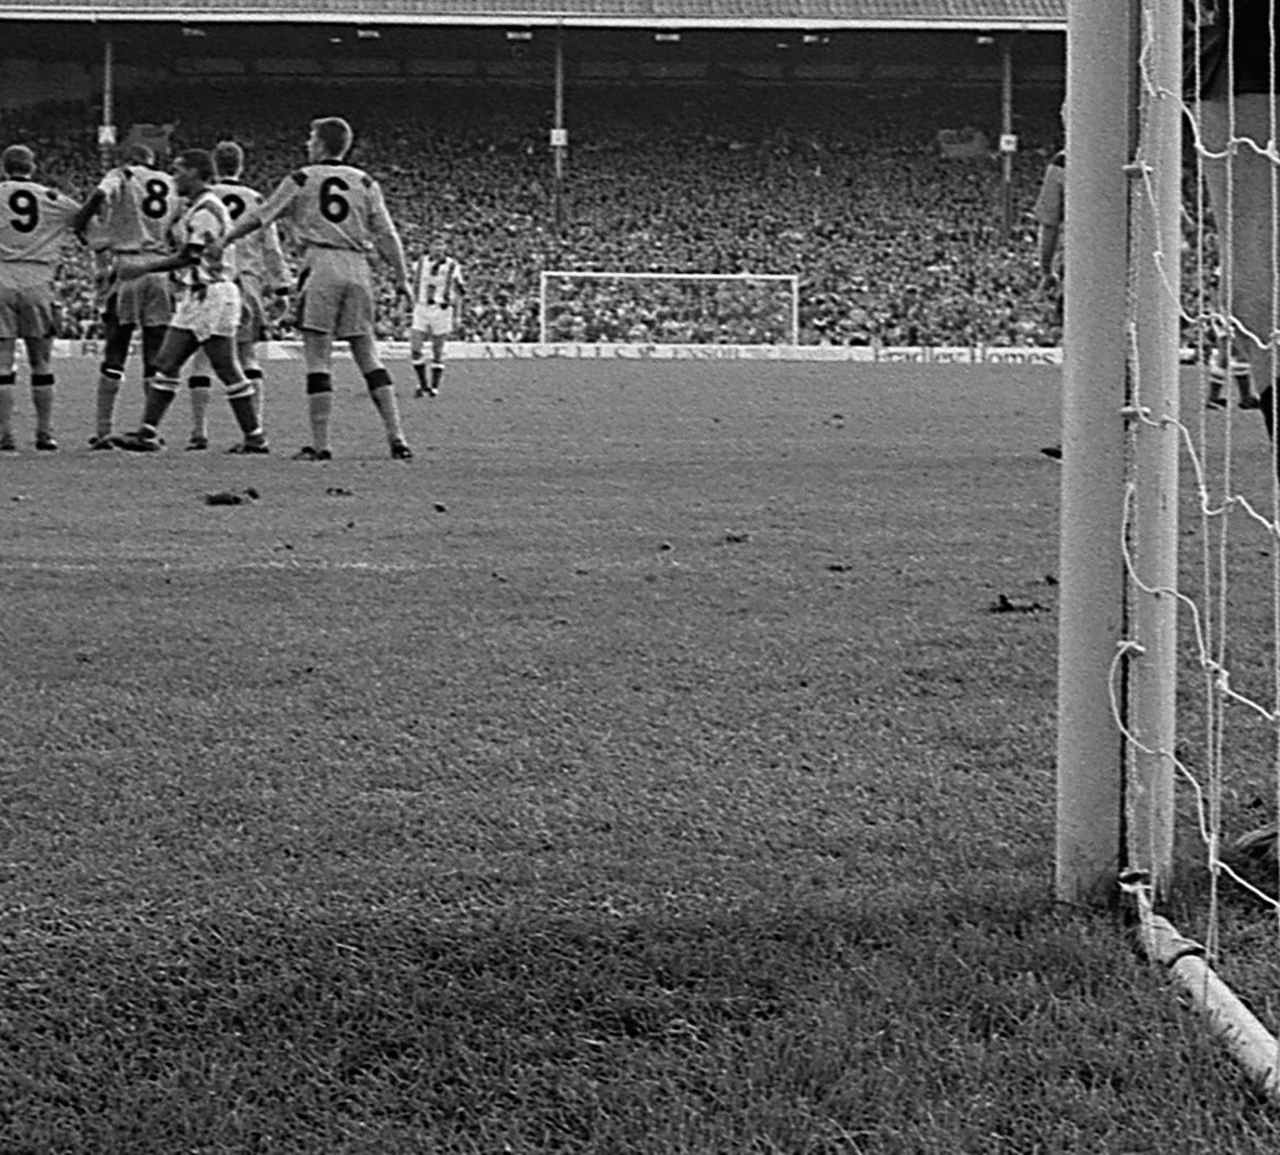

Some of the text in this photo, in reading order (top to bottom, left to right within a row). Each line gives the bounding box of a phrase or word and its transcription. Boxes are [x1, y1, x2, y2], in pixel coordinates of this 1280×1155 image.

[8, 189, 39, 234] 9
[141, 178, 169, 220] 8
[319, 176, 351, 224] 6
